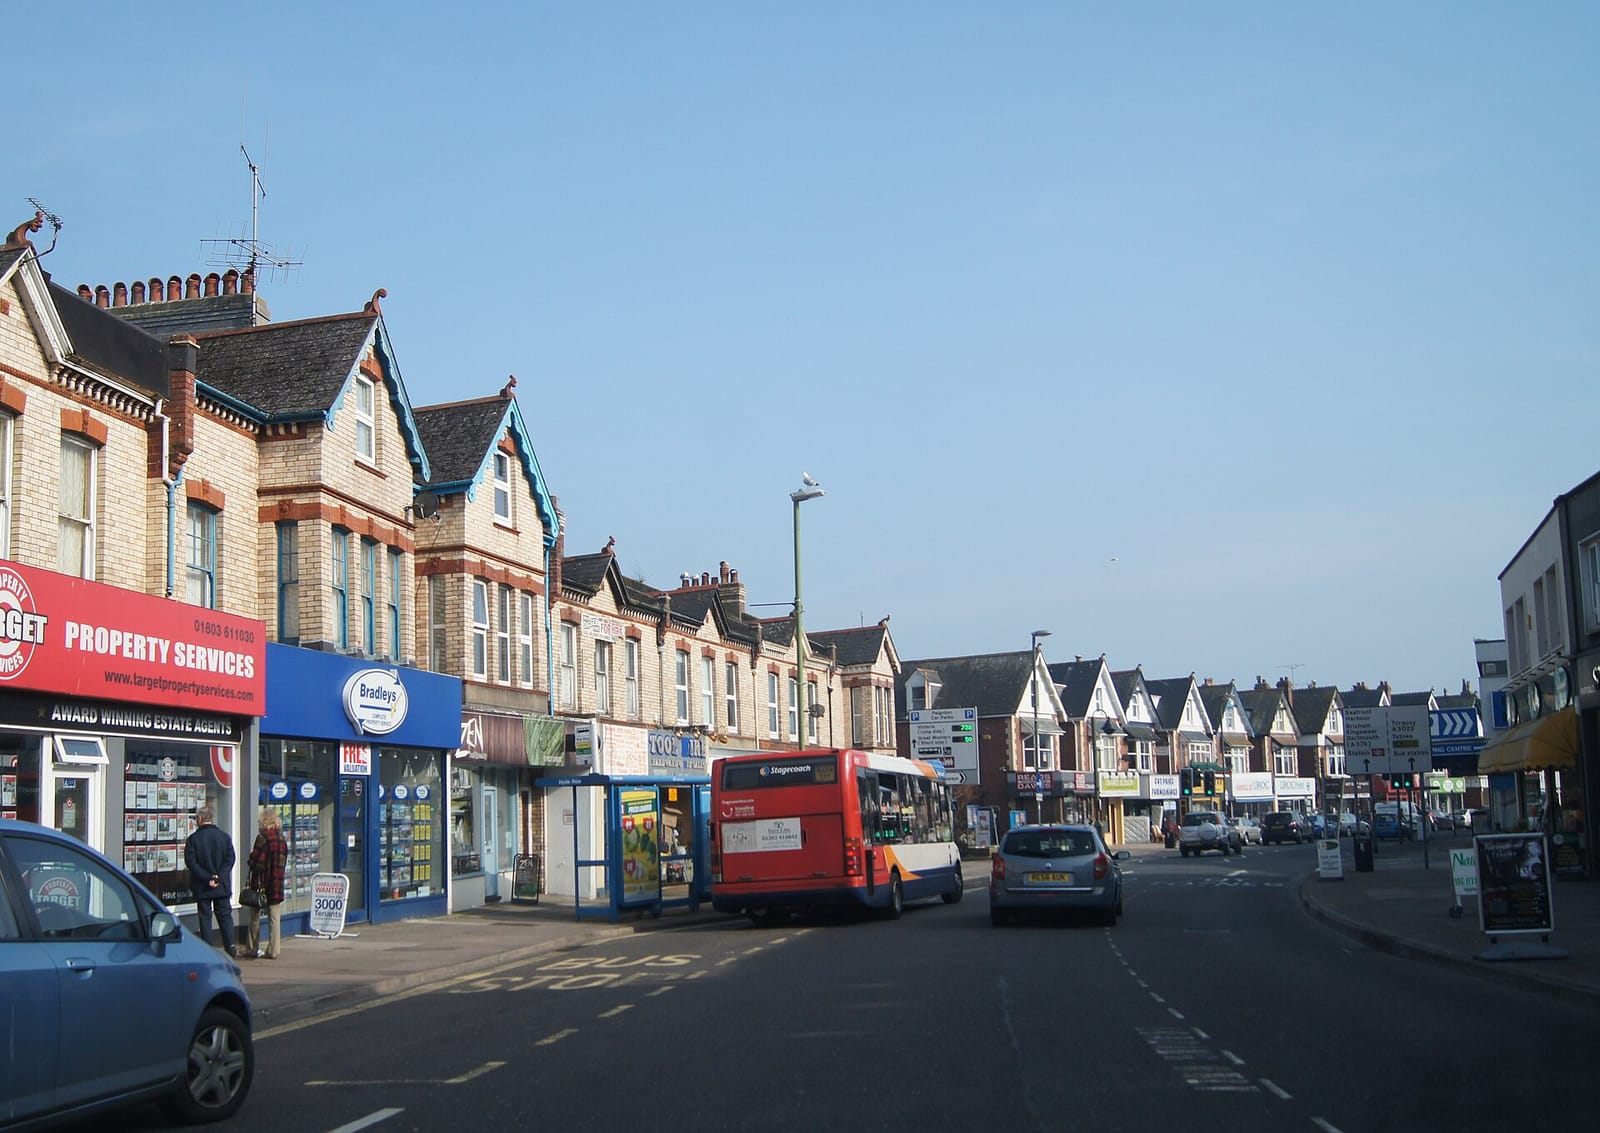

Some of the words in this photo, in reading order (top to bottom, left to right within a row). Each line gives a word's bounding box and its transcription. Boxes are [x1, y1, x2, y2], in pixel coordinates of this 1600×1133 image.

[194, 619, 222, 637] 01803
[224, 623, 255, 643] 611030
[65, 621, 171, 664] PROPERTY
[174, 641, 255, 679] SERVICES
[104, 671, 254, 702] www.targetpropertyservices.com
[360, 683, 397, 705] Bradleys
[51, 704, 98, 723] AWARD
[100, 709, 152, 729] WINNING
[153, 714, 192, 732] ESTATE
[193, 718, 232, 735] AGENTS
[649, 733, 678, 756] TOOL
[343, 764, 368, 773] VALUATION
[770, 764, 811, 775] Stagecoach
[34, 894, 82, 907] TARGET
[315, 898, 343, 910] 3000
[315, 910, 343, 918] Tenants
[536, 954, 702, 971] BUS
